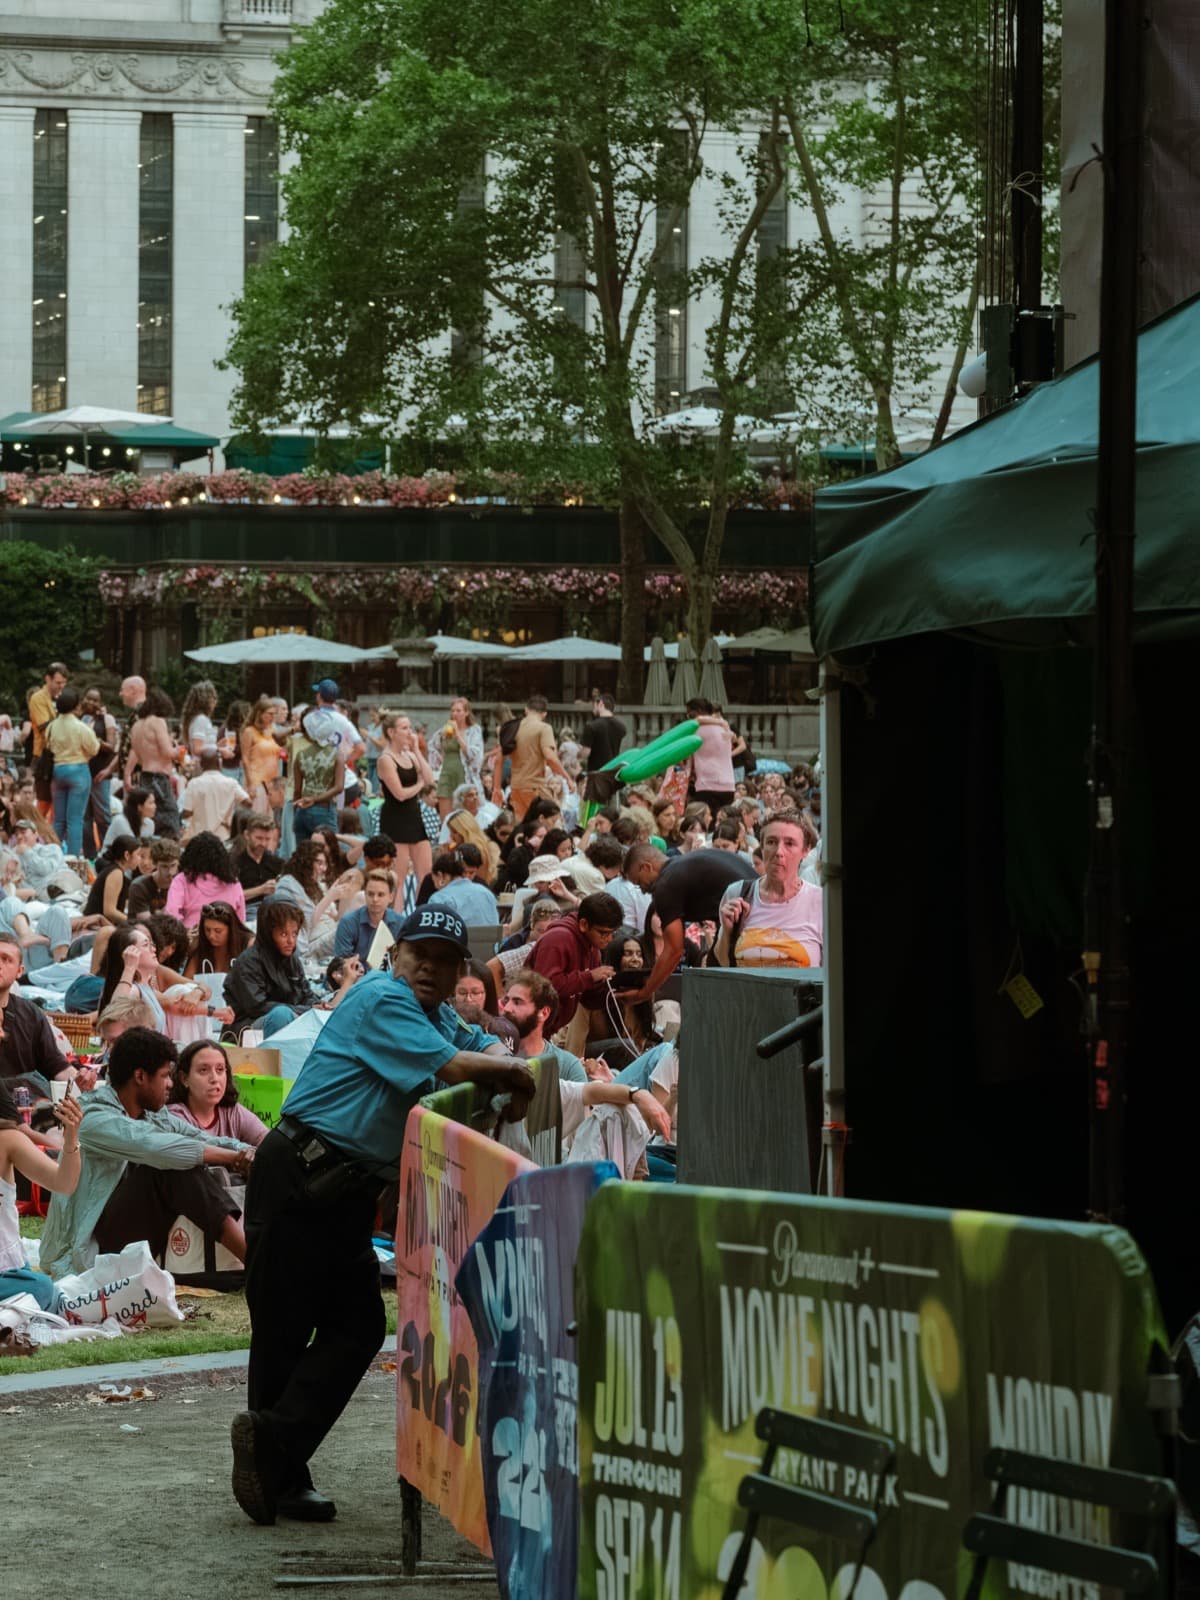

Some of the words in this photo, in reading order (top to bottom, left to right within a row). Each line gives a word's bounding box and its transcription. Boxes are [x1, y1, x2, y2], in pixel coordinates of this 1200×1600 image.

[419, 911, 462, 937] BPPS
[594, 1308, 647, 1448] JUL
[651, 1315, 684, 1457] 13
[719, 1284, 818, 1433] MOVIE
[821, 1298, 949, 1478] NIGHTS
[591, 1452, 683, 1498] THROUGH
[769, 1446, 838, 1493] RYANT
[595, 1494, 646, 1600] SEP
[650, 1505, 682, 1600] 14
